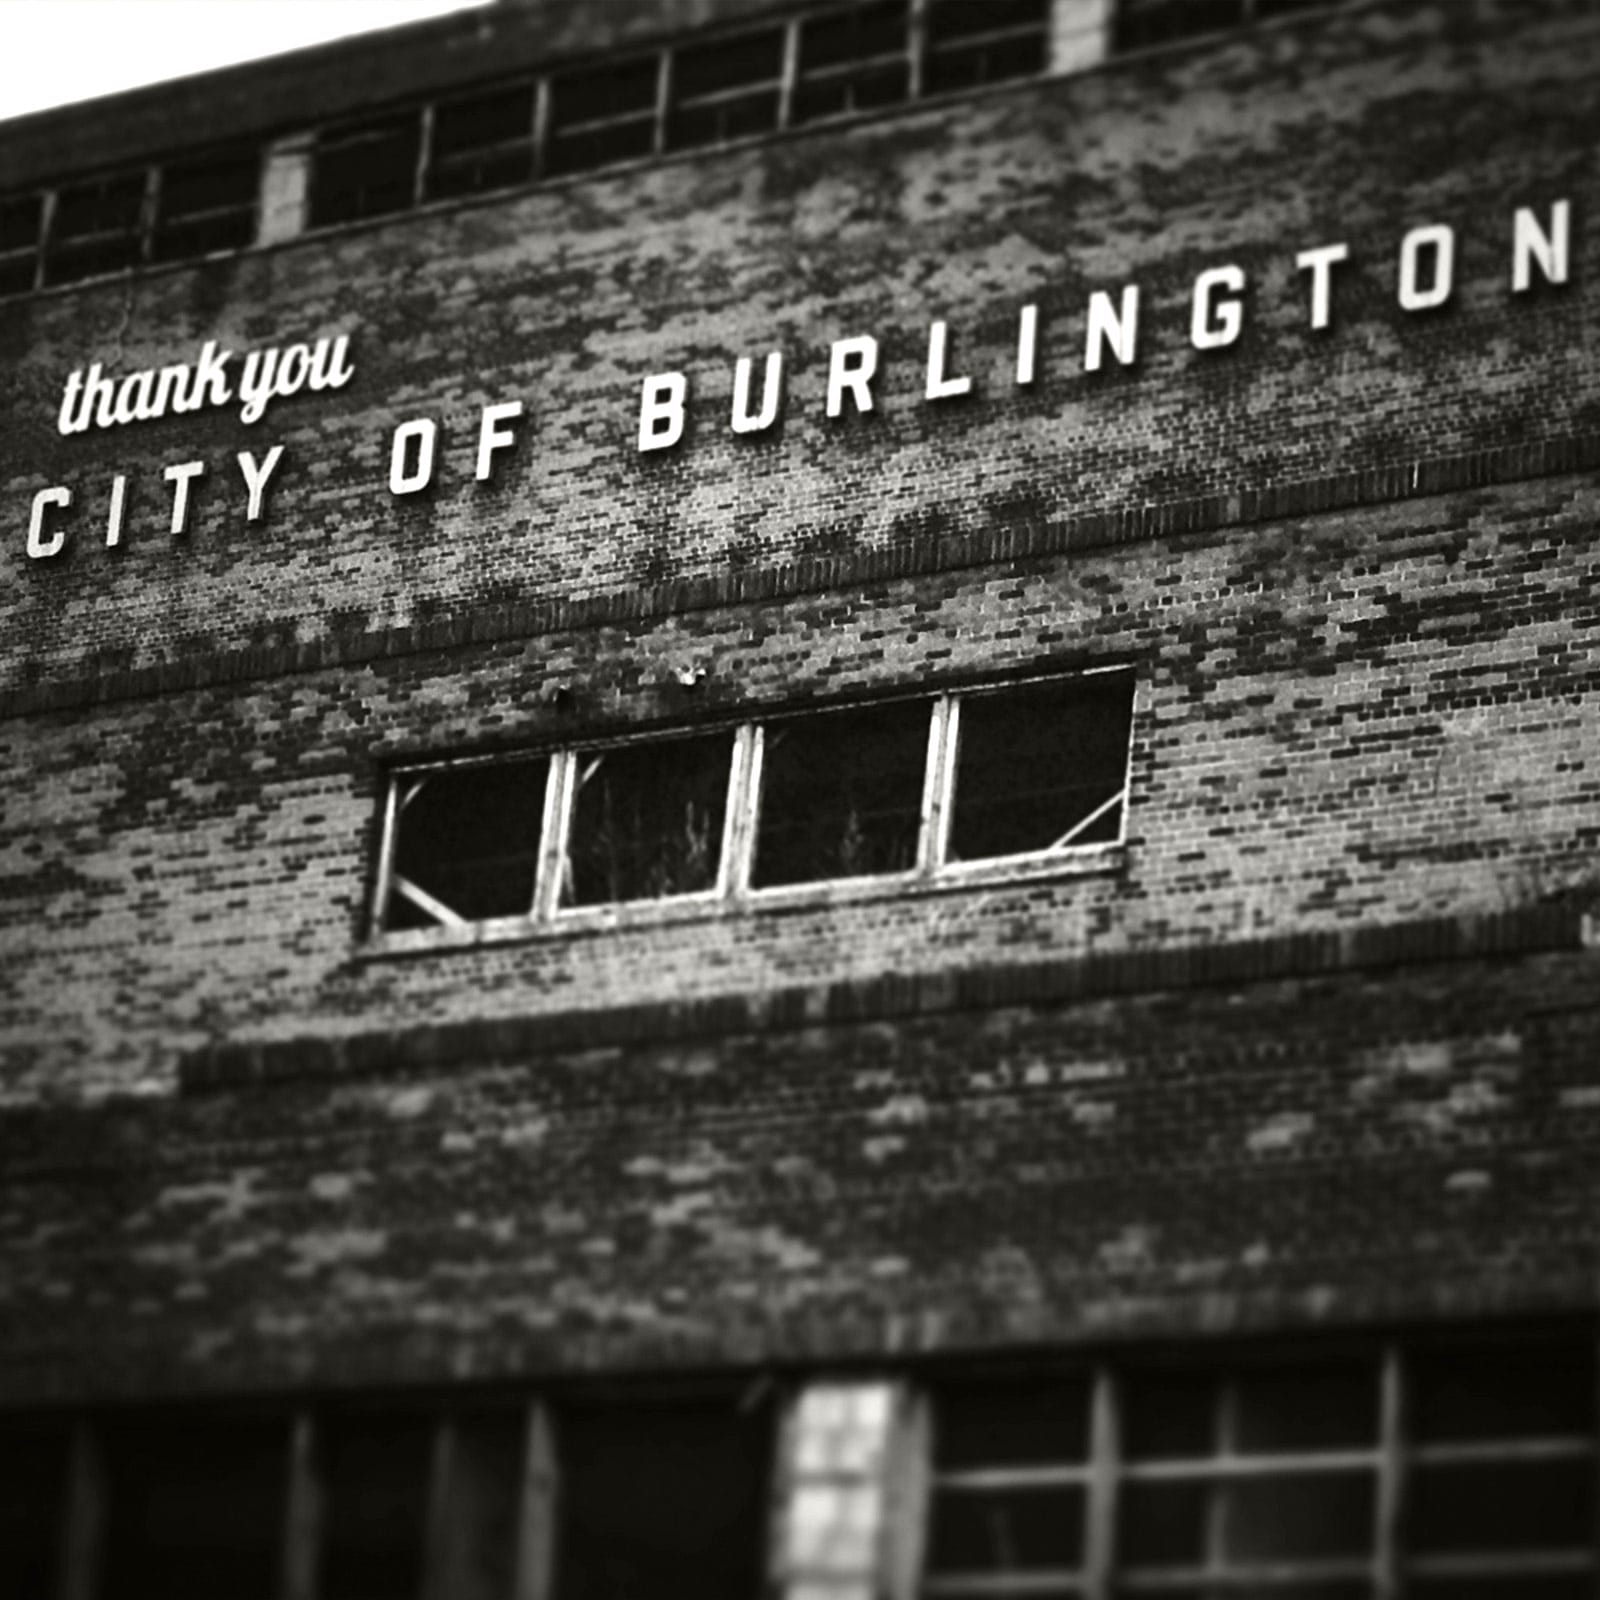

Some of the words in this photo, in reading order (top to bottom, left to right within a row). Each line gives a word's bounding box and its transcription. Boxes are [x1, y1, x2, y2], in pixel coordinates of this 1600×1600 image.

[26, 445, 284, 559] CITY
[388, 400, 523, 495] OF
[637, 200, 1571, 453] BURLINGTON
[57, 340, 232, 435] thank
[239, 334, 354, 424] you
